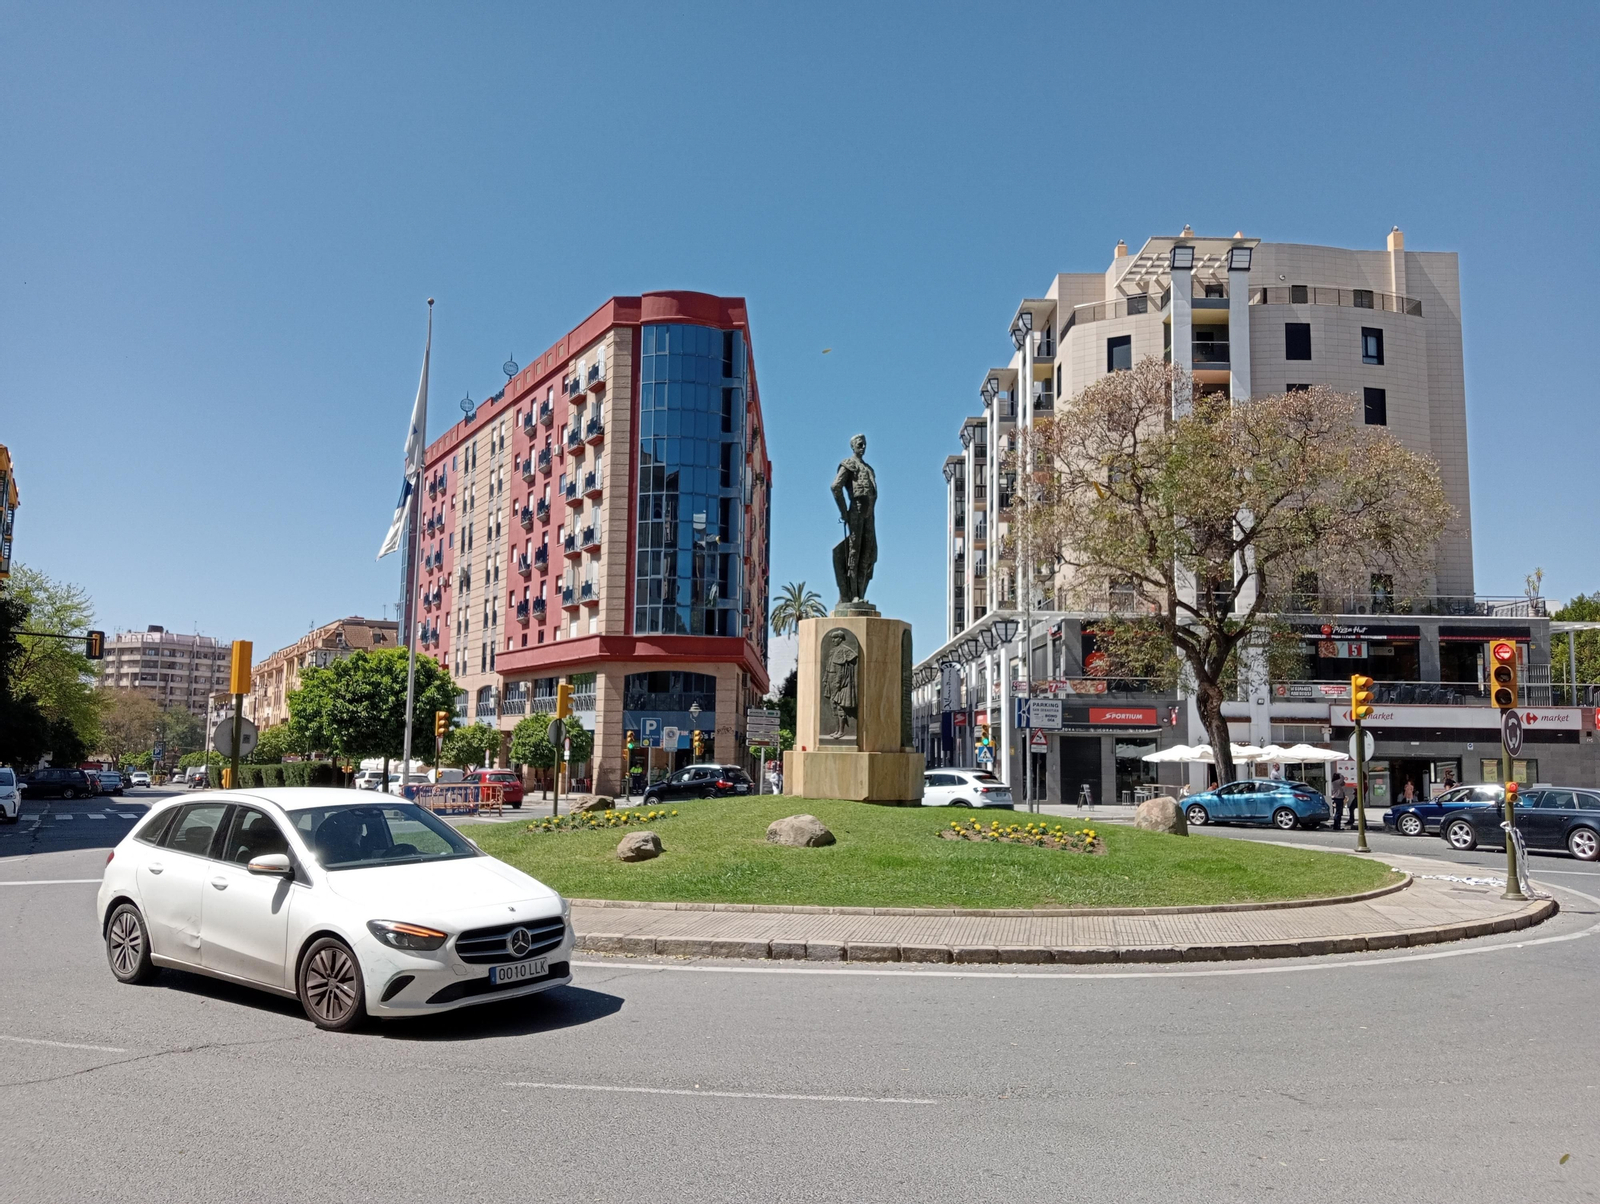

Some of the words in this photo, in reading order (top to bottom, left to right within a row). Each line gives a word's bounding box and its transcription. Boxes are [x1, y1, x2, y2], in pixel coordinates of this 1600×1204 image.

[1333, 626, 1352, 634] Pizza
[1101, 712, 1143, 720] SPORTIUM
[1367, 712, 1394, 720] market
[1541, 714, 1569, 722] market
[645, 720, 657, 735] P
[499, 964, 526, 980] 0010
[529, 960, 546, 975] LLK
